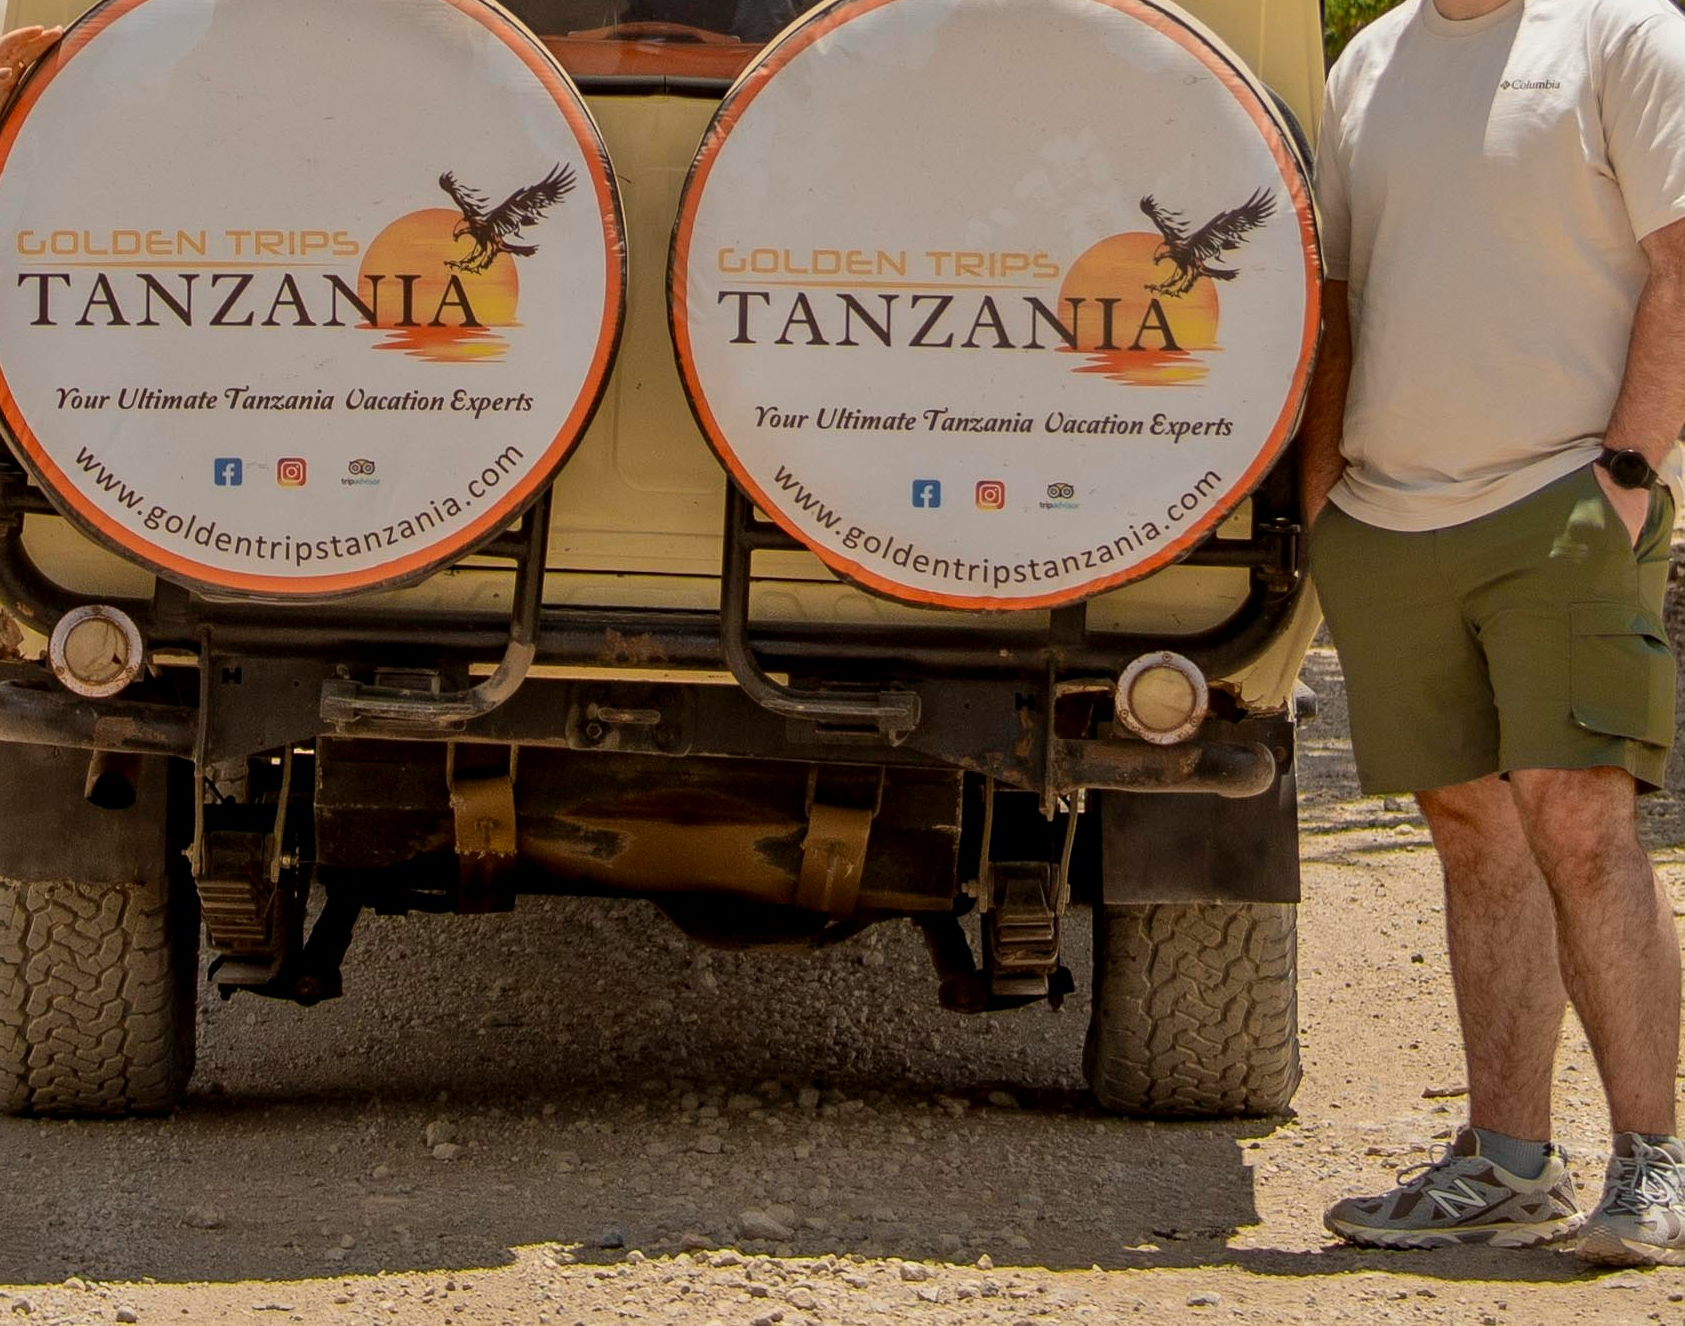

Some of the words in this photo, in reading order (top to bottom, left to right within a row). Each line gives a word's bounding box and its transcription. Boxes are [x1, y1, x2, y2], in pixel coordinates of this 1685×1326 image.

[1511, 79, 1561, 90] Columbia
[17, 230, 207, 256] GOLDEN
[225, 230, 360, 257] TRIPS
[717, 248, 907, 277] GOLDEN
[926, 250, 1060, 279] TRIPS
[17, 272, 485, 327] TANZANIA
[717, 290, 1183, 351] TANZANIA
[55, 387, 110, 412] Your
[117, 387, 218, 412] Ultimate
[224, 386, 334, 412] Tanzania
[345, 388, 445, 413] Vacation
[450, 389, 534, 419] Experts
[754, 405, 809, 430] Your
[816, 407, 917, 432] Ultimate
[923, 407, 1034, 434] Tanzania
[1045, 409, 1145, 436] Vacation
[1149, 413, 1235, 444] Experts
[75, 445, 524, 567] www.goldentripstanzania.com
[773, 465, 1223, 589] www.goldentripstanzania.com
